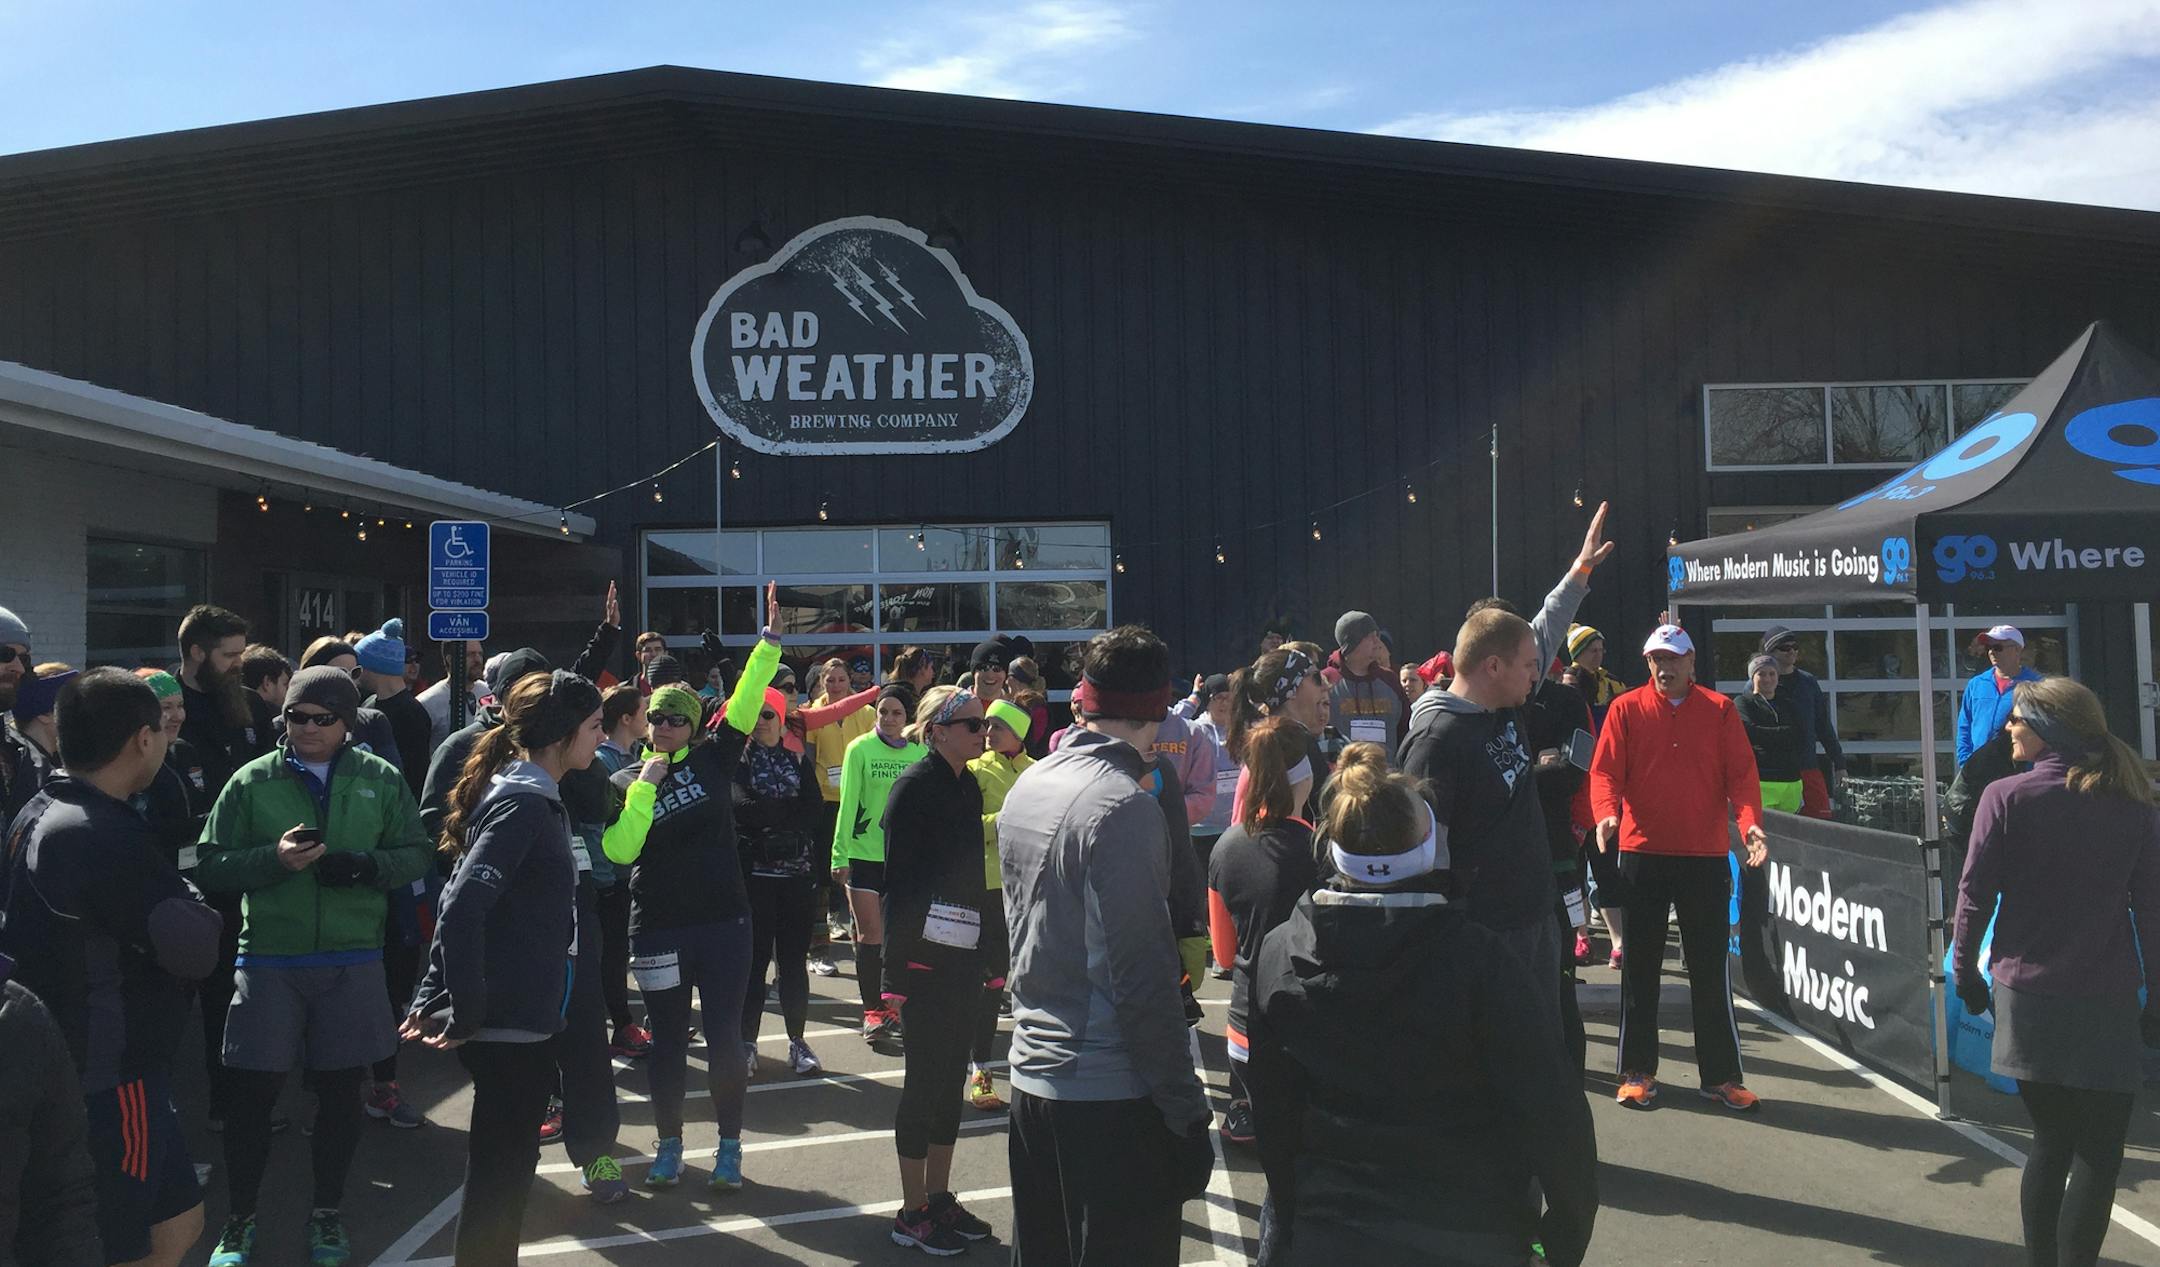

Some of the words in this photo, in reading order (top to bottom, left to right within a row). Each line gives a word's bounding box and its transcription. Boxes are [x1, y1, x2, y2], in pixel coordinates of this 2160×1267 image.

[731, 312, 819, 349] BAD
[732, 353, 998, 401] WEATHER
[790, 414, 871, 429] BREWING
[877, 413, 959, 428] COMPANY
[1685, 558, 1721, 582] Where
[1724, 553, 1768, 580] Modern
[1772, 550, 1810, 577] Music
[1814, 549, 1827, 577] is
[1831, 546, 1879, 583] Going
[1882, 537, 1910, 585] go
[1932, 534, 1998, 583] go
[2008, 538, 2145, 570] Where
[1970, 571, 1996, 580] 96.3
[300, 591, 335, 628] 414
[449, 617, 470, 626] VAN
[1769, 861, 1887, 952] Modern
[1783, 941, 1875, 1029] Music
